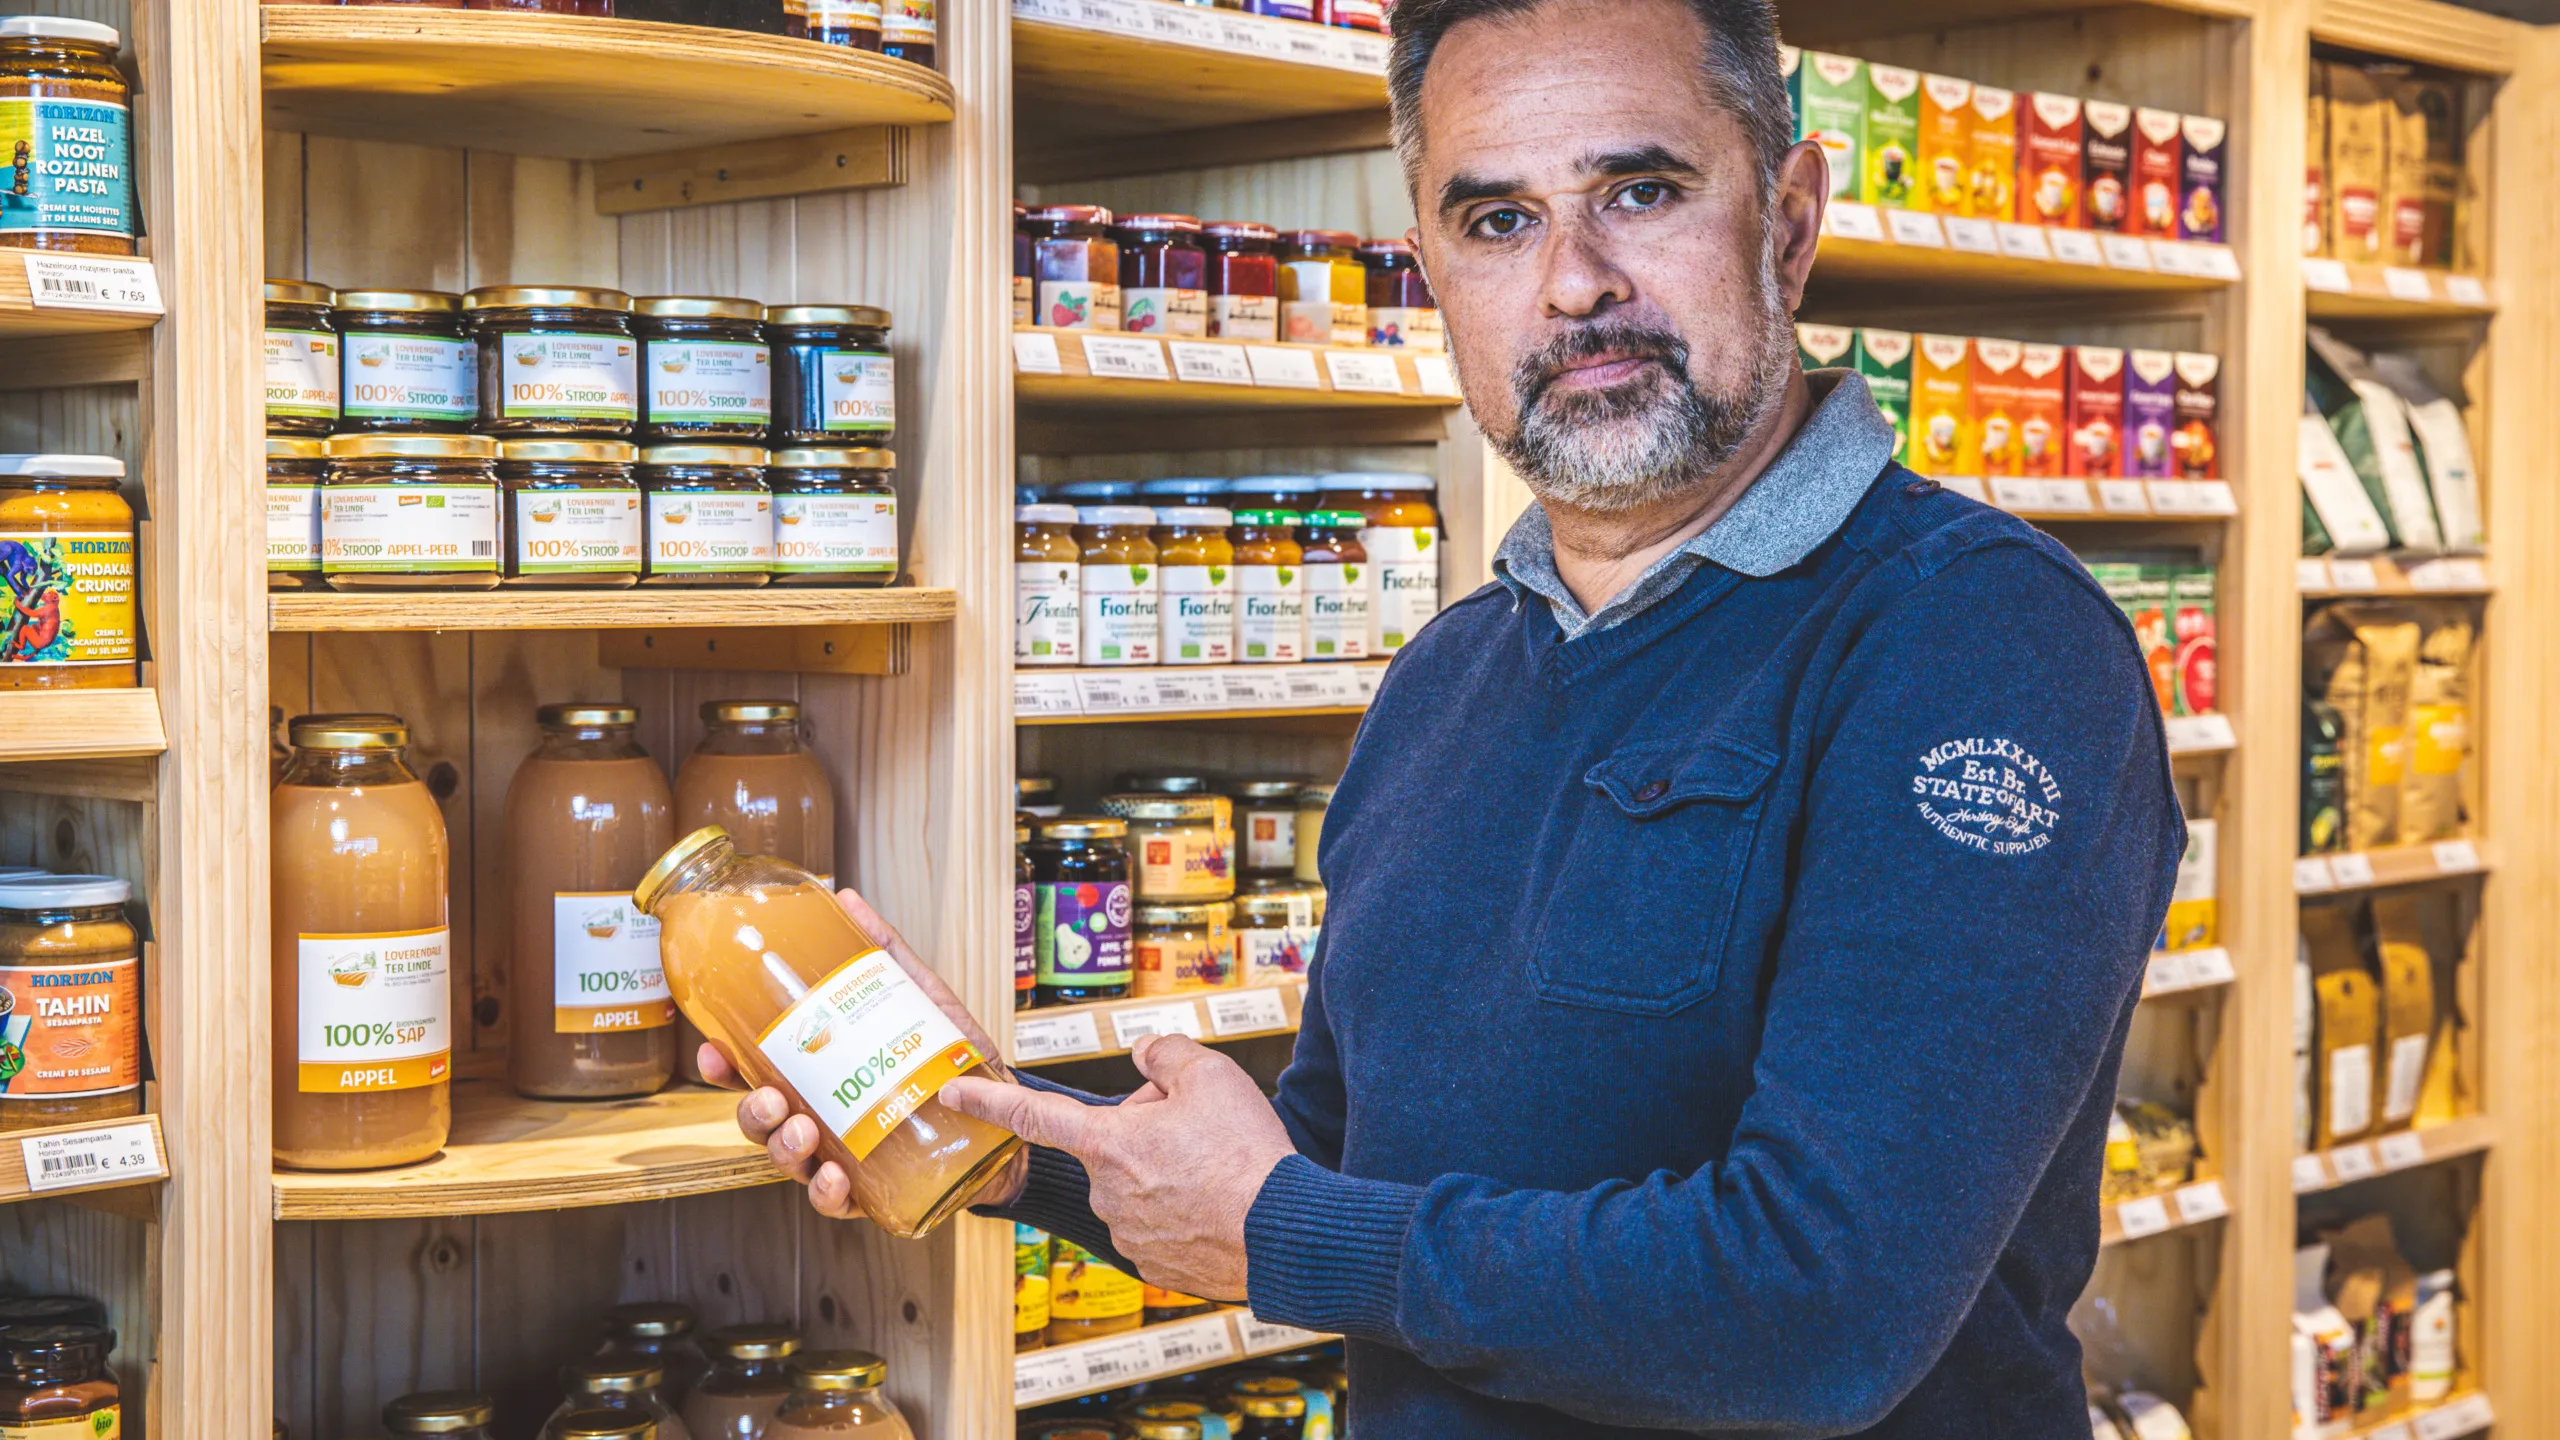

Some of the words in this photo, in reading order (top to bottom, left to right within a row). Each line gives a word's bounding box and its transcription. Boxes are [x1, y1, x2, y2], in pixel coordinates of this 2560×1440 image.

[36, 104, 115, 124] HORIZON
[52, 126, 106, 143] HAZEL
[55, 143, 105, 160] NOOT
[36, 160, 119, 179] ROZIJNEN
[55, 178, 107, 195] PASTA
[38, 204, 67, 212] CREME
[69, 204, 80, 213] DE
[42, 214, 49, 222] ET
[68, 215, 101, 224] RAISINS
[37, 261, 77, 270] Hazelnoot
[113, 267, 135, 275] pasta
[101, 289, 110, 299] €
[395, 344, 446, 355] LOVERENDALE
[552, 342, 603, 353] LOVERENDALE
[396, 353, 409, 362] TER
[412, 354, 433, 363] LINDE
[552, 351, 566, 360] TER
[568, 351, 592, 361] LINDE
[696, 358, 710, 367] TER
[712, 358, 733, 368] LINDE
[354, 384, 406, 402] 100%
[408, 391, 448, 405] STROOP
[512, 383, 563, 401] 100%
[565, 389, 607, 402] STROOP
[658, 390, 707, 407] 100%
[709, 395, 747, 408] STROOP
[833, 400, 874, 416] 100%
[333, 495, 377, 504] LOVERENDALE
[567, 498, 616, 507] LOVERENDALE
[697, 500, 745, 508] LOVERENDALE
[334, 504, 344, 513] TER
[346, 504, 364, 513] LINDE
[568, 507, 581, 515] TER
[583, 507, 605, 515] LINDE
[698, 508, 711, 517] TER
[713, 508, 734, 517] LINDE
[812, 511, 825, 519] TER
[827, 511, 848, 519] LINDE
[342, 544, 382, 556] STROOP
[387, 543, 458, 556] APPEL-PEER
[528, 540, 579, 557] 100%
[581, 545, 620, 557] STROOP
[659, 541, 708, 558] 100%
[710, 545, 749, 558] STROOP
[776, 541, 821, 558] 100%
[824, 545, 863, 558] STROOP
[75, 580, 131, 593] CRUNCHY
[86, 595, 101, 603] MET
[68, 638, 115, 647] CACAHUETES
[86, 646, 97, 655] AU
[1920, 738, 2062, 803] MCMLXXXVII
[1962, 759, 1998, 784] Est.
[1912, 775, 1997, 805] STATE
[2012, 798, 2060, 829] ART
[1947, 807, 2005, 833] Heritage
[1917, 801, 1990, 851] AUTHENTIC
[1993, 832, 2051, 855] SUPPLIER
[385, 945, 441, 961] LOVERENDALE
[385, 963, 404, 974] TER
[407, 960, 431, 972] LINDE
[31, 970, 114, 987] HORIZON
[579, 969, 639, 992] 100%
[640, 974, 663, 990] SAP
[829, 963, 887, 1006] LOVERENDALE
[837, 997, 859, 1014] TER
[857, 978, 884, 1000] LINDE
[36, 995, 110, 1017] TAHIN
[46, 1016, 102, 1027] SESAMPASTA
[592, 1011, 641, 1028] APPEL
[324, 1022, 394, 1047] 100%
[397, 1026, 425, 1044] SAP
[892, 1032, 922, 1061] SAP
[37, 1069, 66, 1079] CREME
[68, 1068, 79, 1077] DE
[81, 1066, 111, 1075] SESAME
[340, 1069, 397, 1087] APPEL
[832, 1048, 896, 1109] 100%
[875, 1081, 928, 1131] APPEL
[37, 1141, 60, 1149] Tahin
[62, 1134, 112, 1146] Sesampasta
[101, 1158, 110, 1168] €
[120, 1154, 145, 1167] 4,39
[96, 1415, 112, 1431] bio
